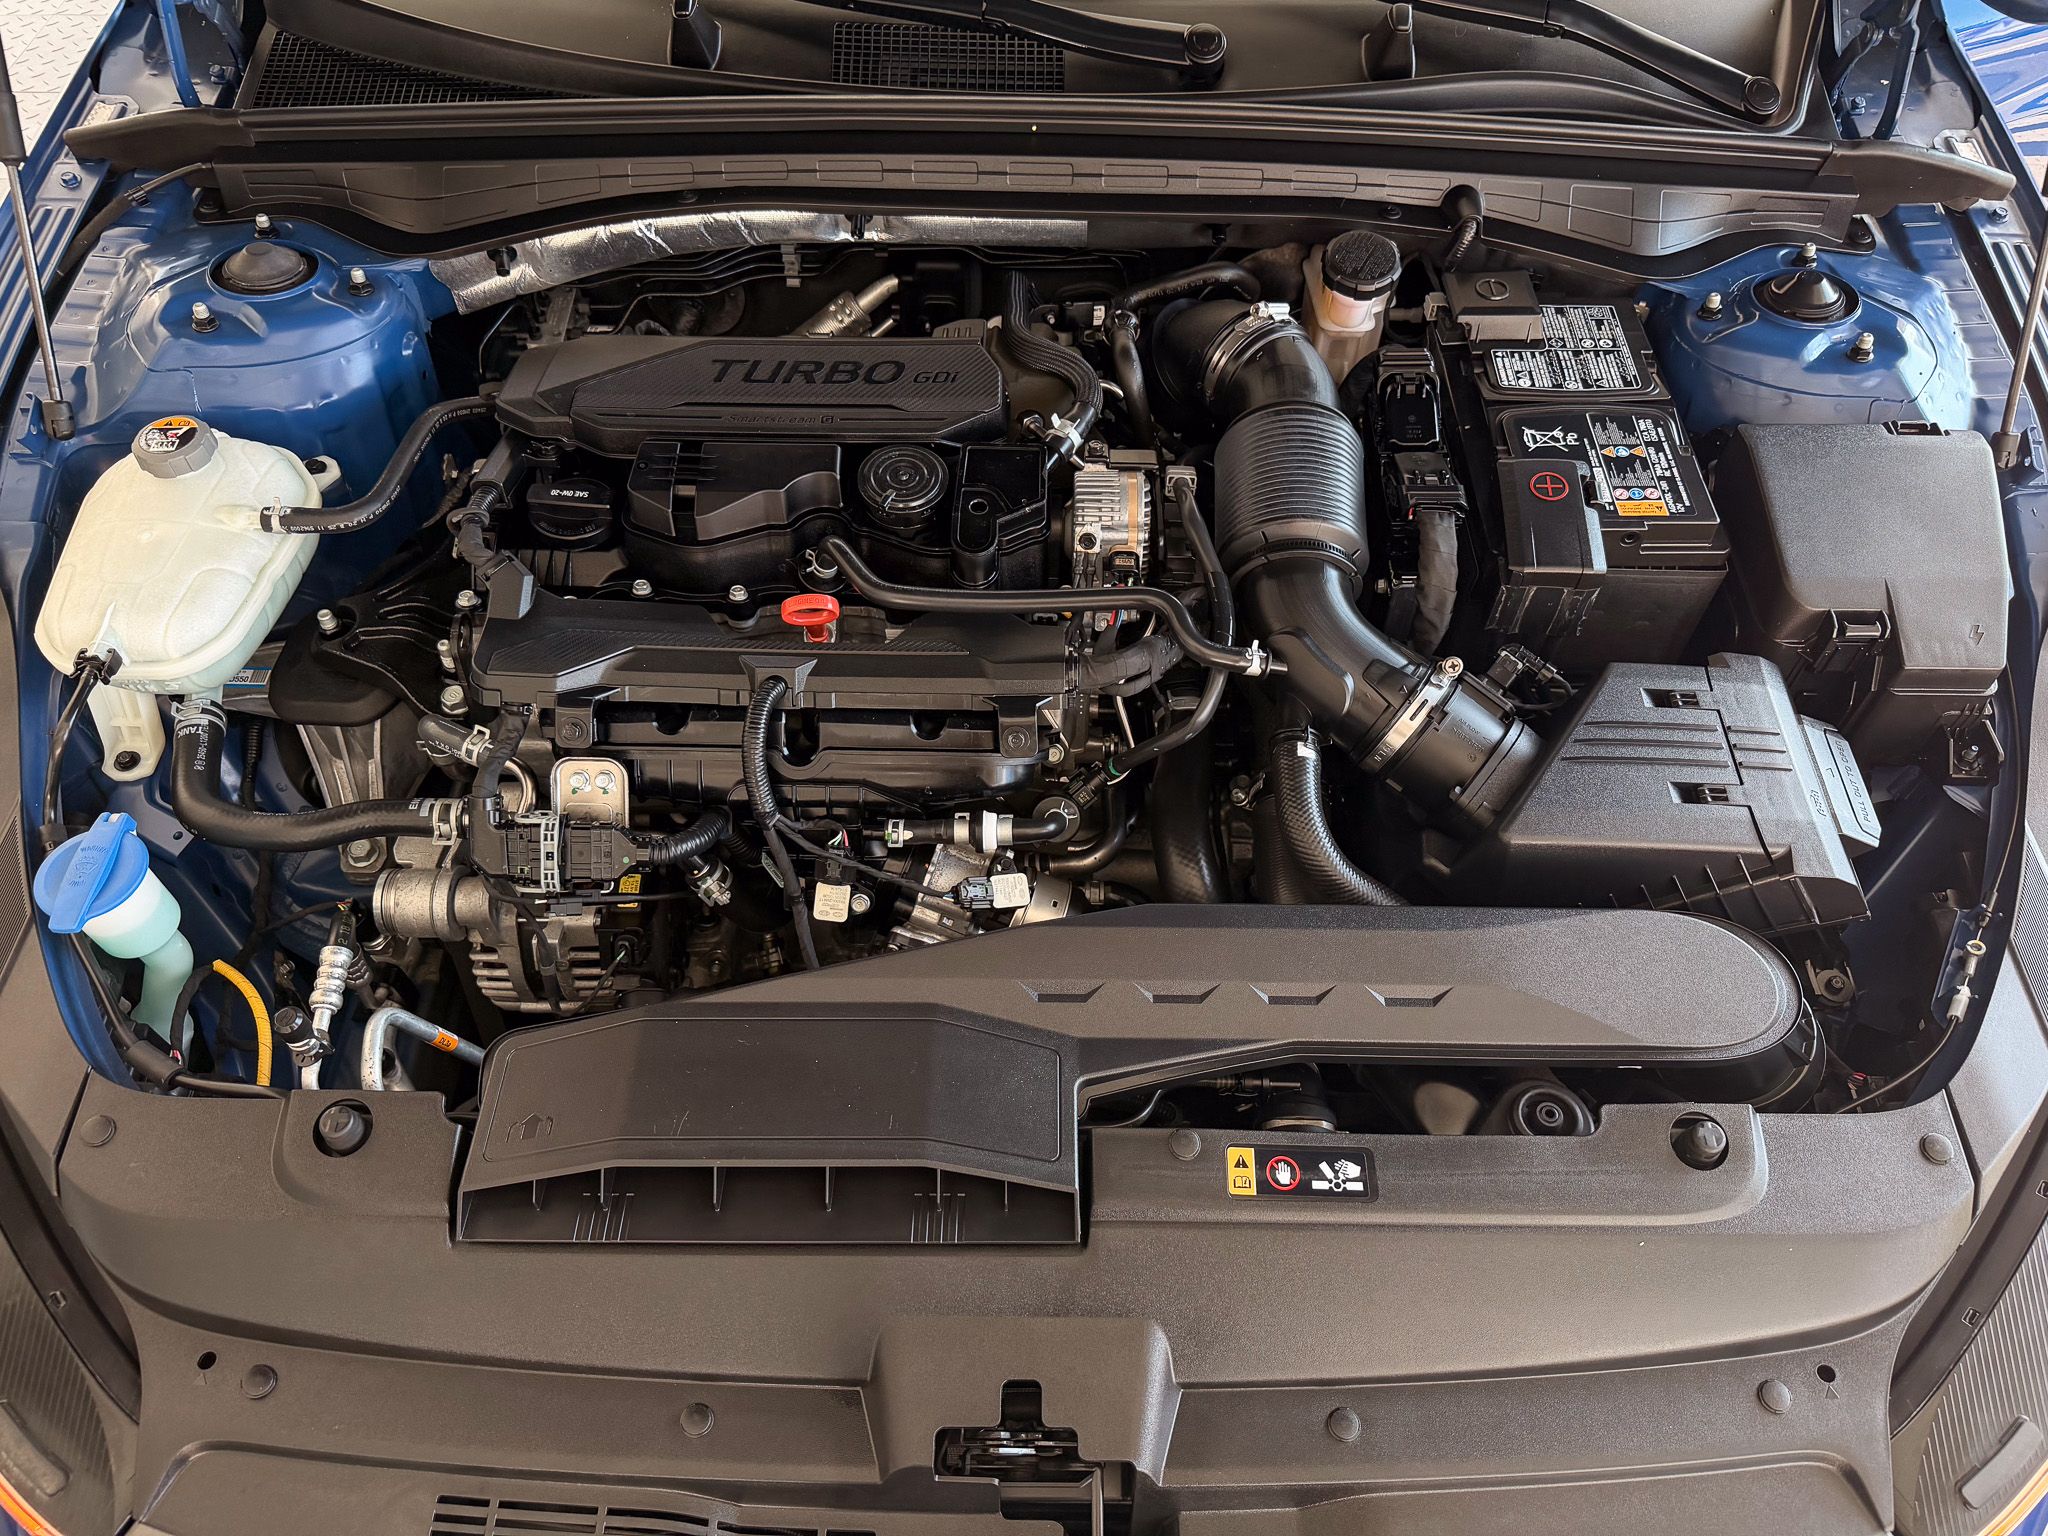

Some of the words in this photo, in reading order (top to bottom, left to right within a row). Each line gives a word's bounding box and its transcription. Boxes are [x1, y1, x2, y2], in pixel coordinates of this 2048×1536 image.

[712, 359, 906, 385] TURBO
[913, 371, 959, 385] GDi
[1566, 432, 1580, 445] Pb
[1642, 431, 1651, 442] CCA
[550, 489, 574, 497] 0W-20
[574, 490, 590, 498] SAE
[1675, 502, 1686, 513] 12V
[177, 726, 203, 739] TANK
[1835, 741, 1849, 763] OPEN
[1845, 765, 1854, 777] TO
[1850, 779, 1862, 798] OUT
[1858, 801, 1871, 823] PULL
